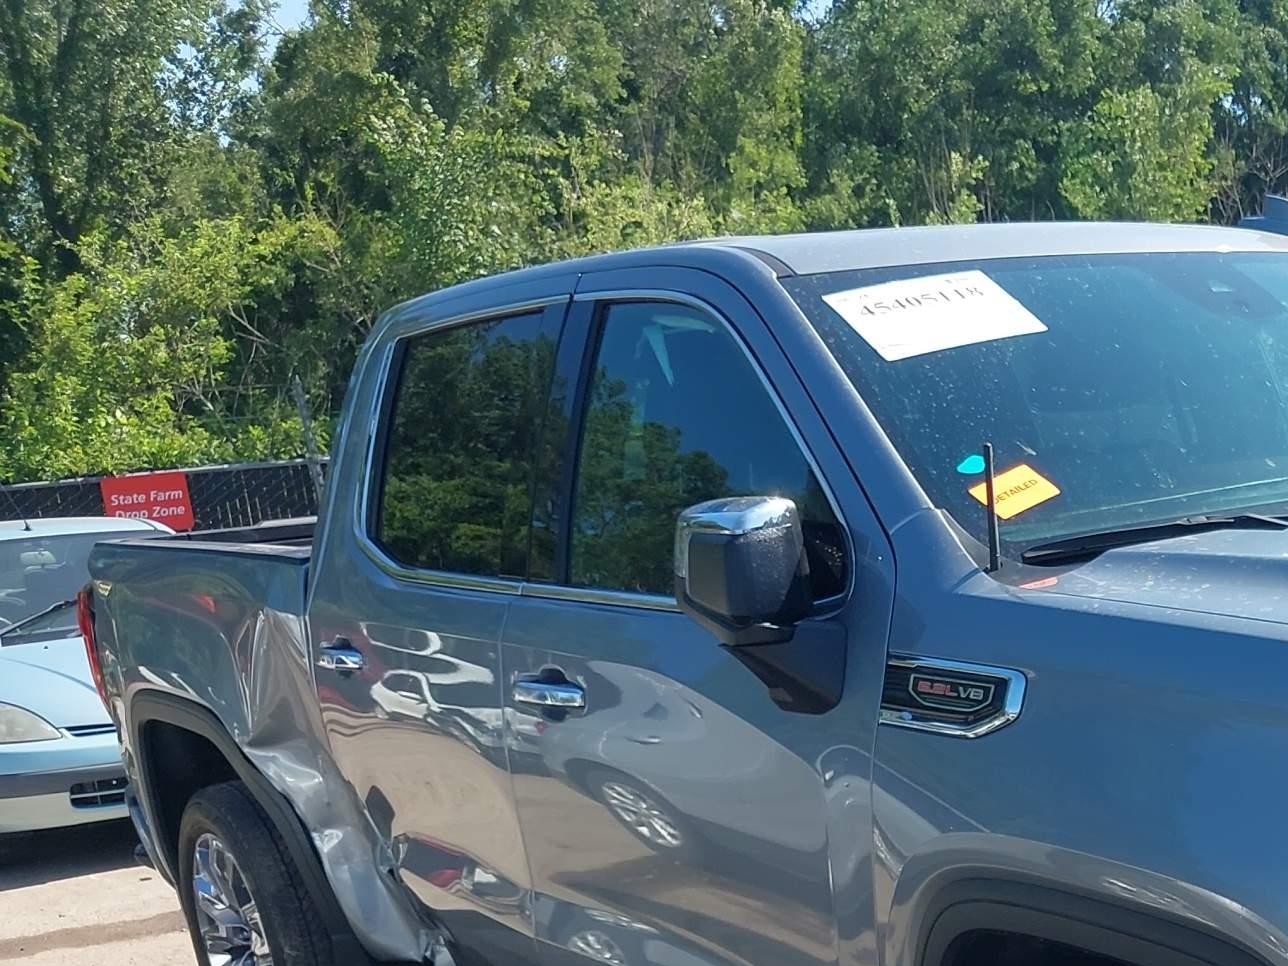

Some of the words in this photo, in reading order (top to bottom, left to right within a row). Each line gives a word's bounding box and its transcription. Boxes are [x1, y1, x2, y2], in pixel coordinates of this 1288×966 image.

[111, 494, 145, 506] State
[150, 490, 183, 502] Farm
[152, 505, 185, 518] Zone
